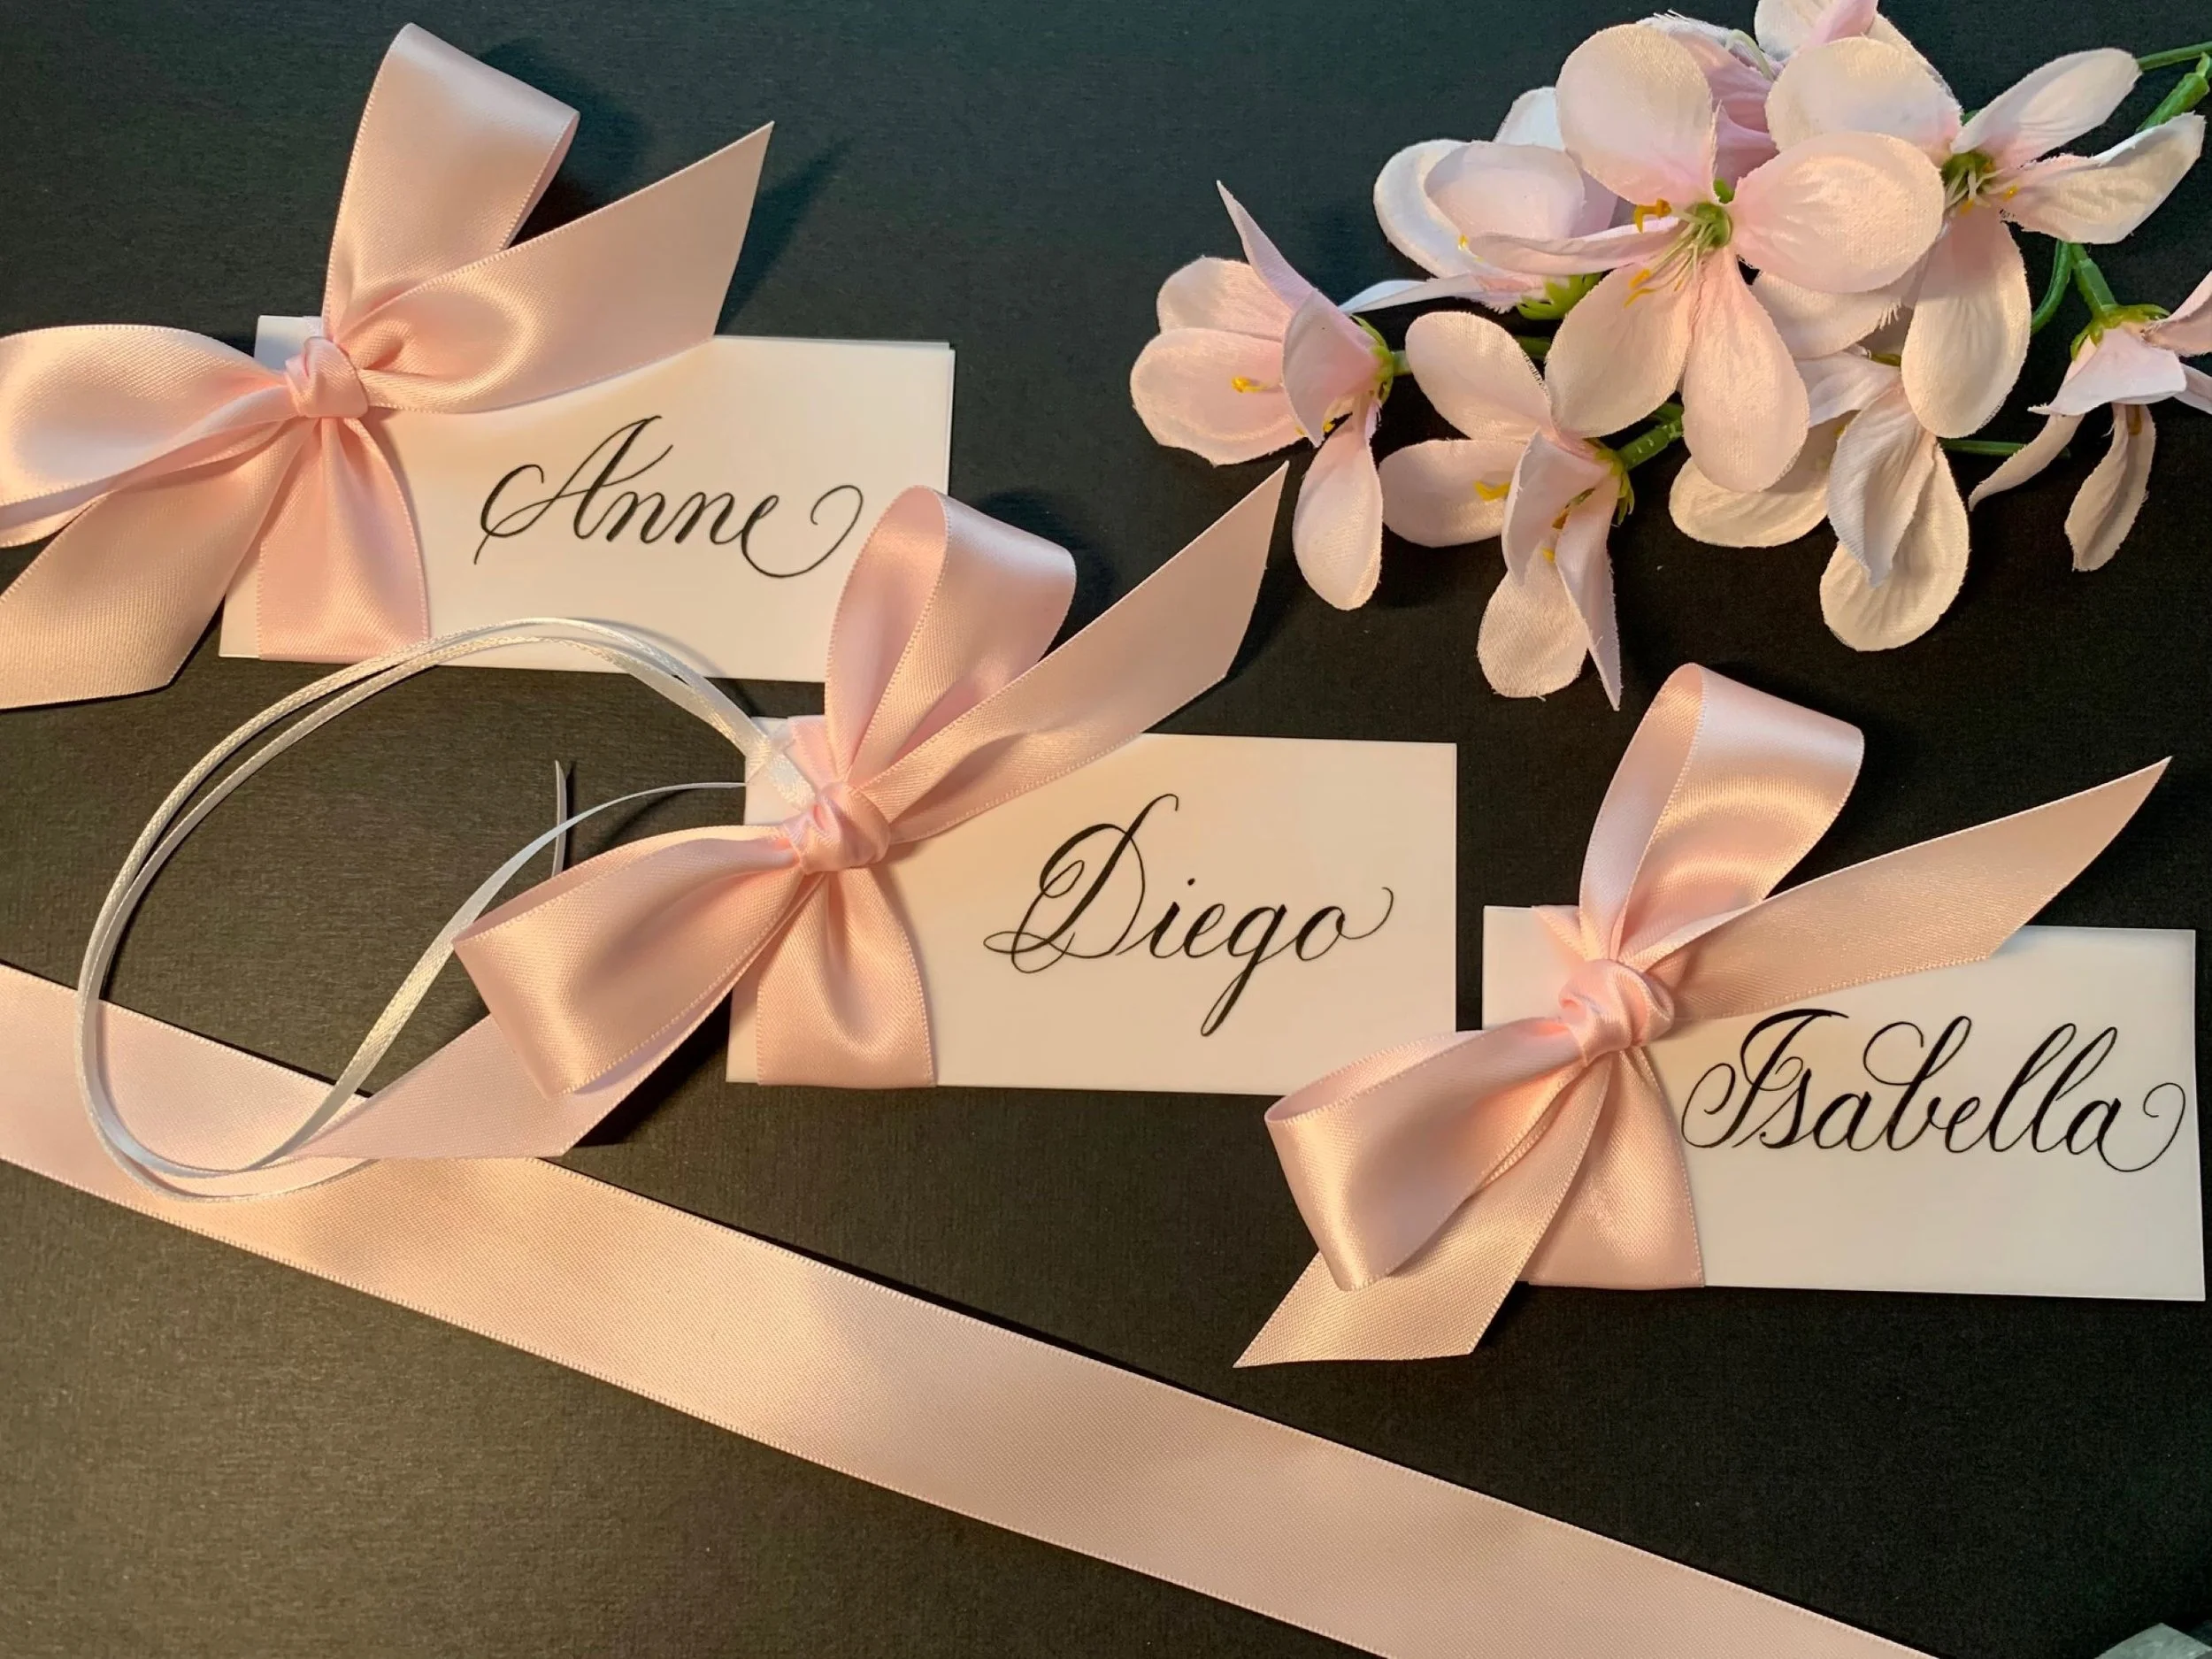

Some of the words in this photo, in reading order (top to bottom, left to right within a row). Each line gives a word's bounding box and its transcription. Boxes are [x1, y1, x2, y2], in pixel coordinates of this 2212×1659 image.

[474, 416, 863, 579] Anne
[983, 793, 1394, 1037] Diego
[1681, 1009, 2186, 1173] Isabella
